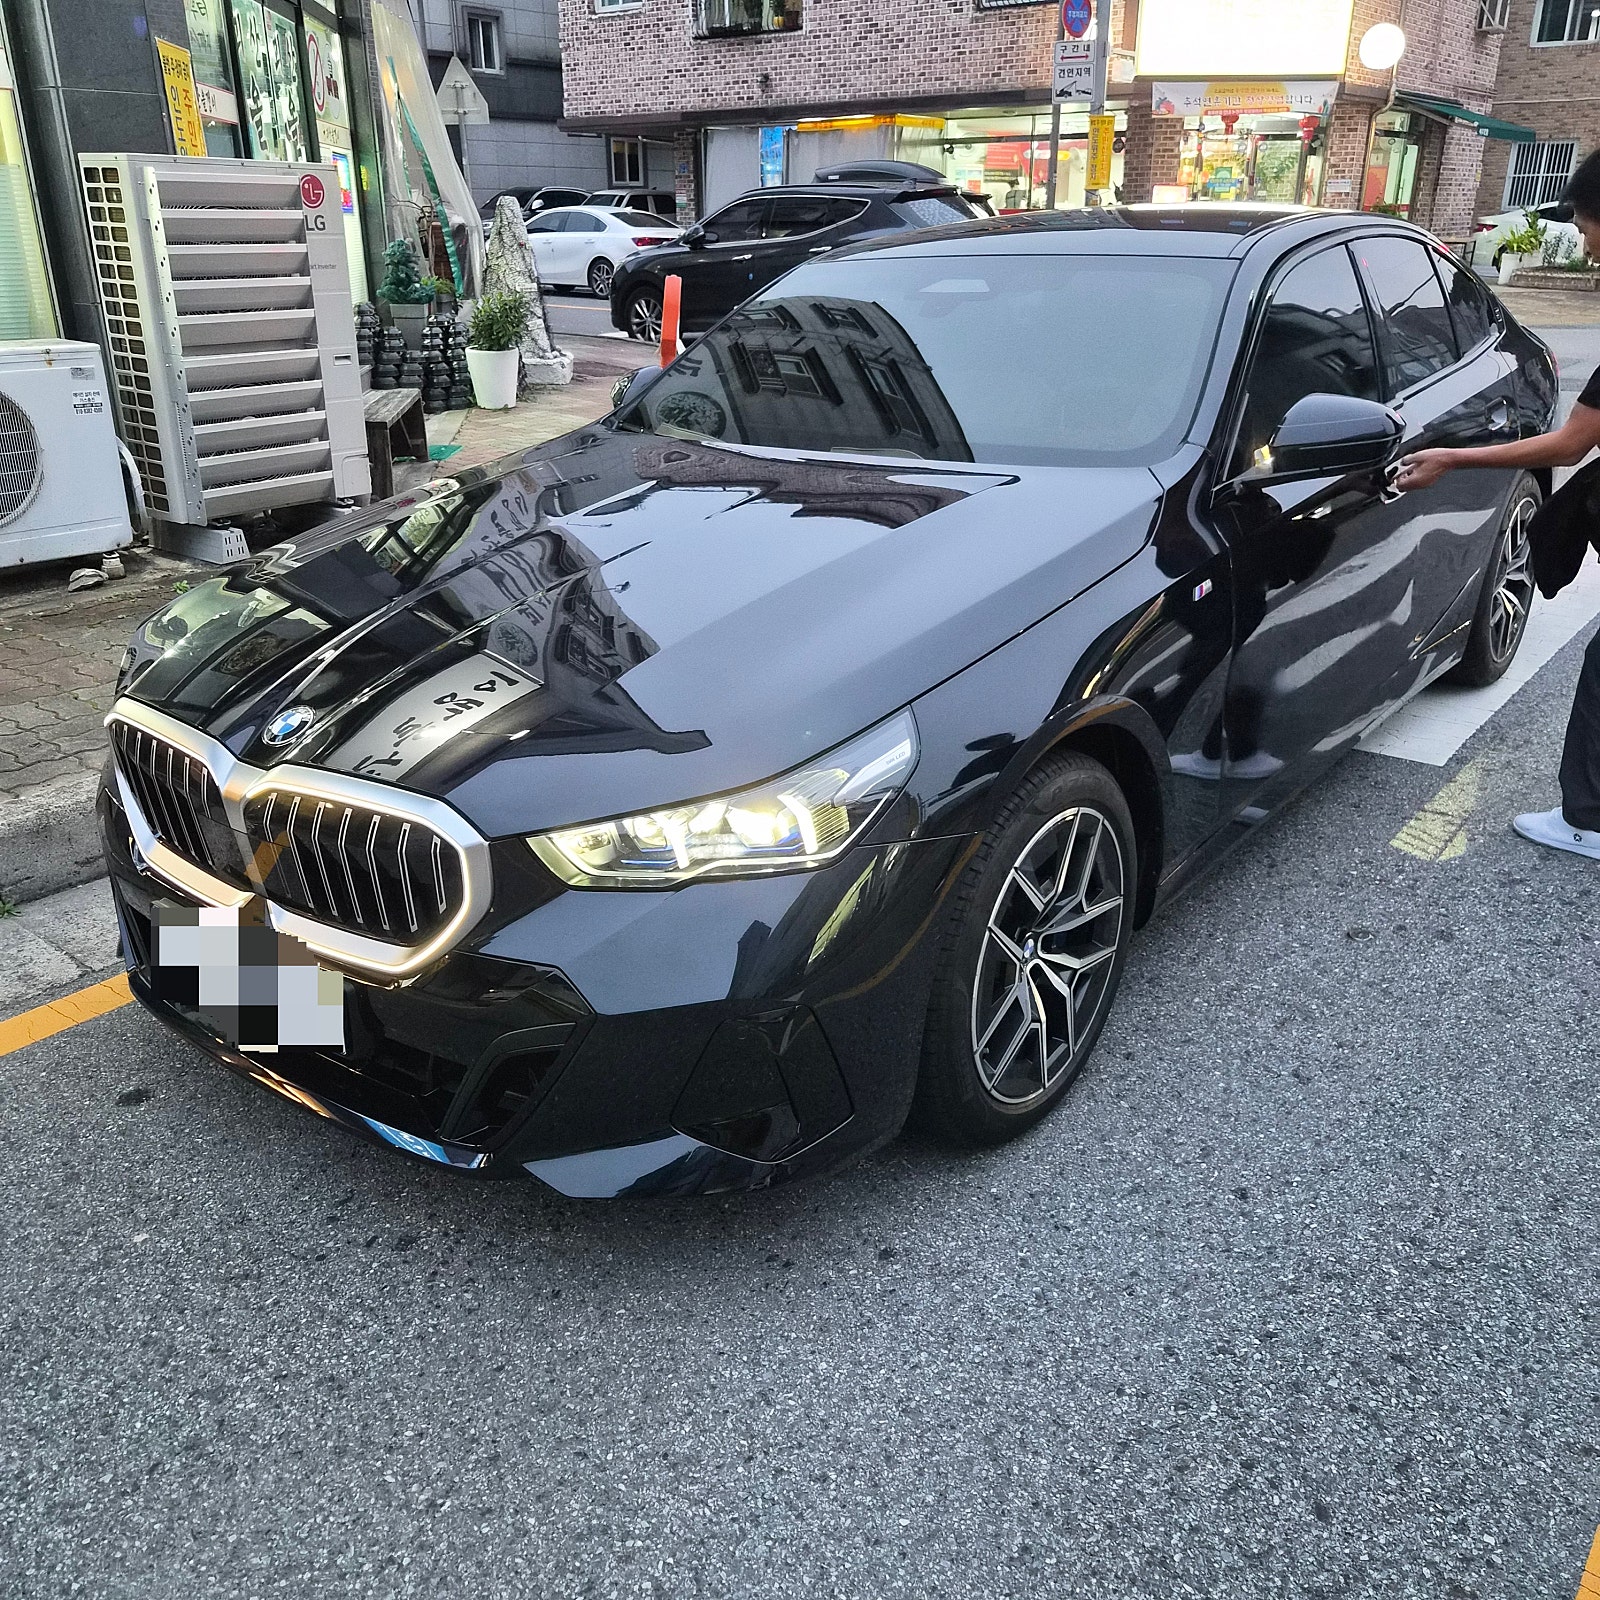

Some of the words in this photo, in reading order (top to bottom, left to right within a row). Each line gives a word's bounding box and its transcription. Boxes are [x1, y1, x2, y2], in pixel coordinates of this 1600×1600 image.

[1058, 67, 1091, 78] 견인지역
[182, 88, 200, 156] 주민
[304, 214, 326, 232] LG
